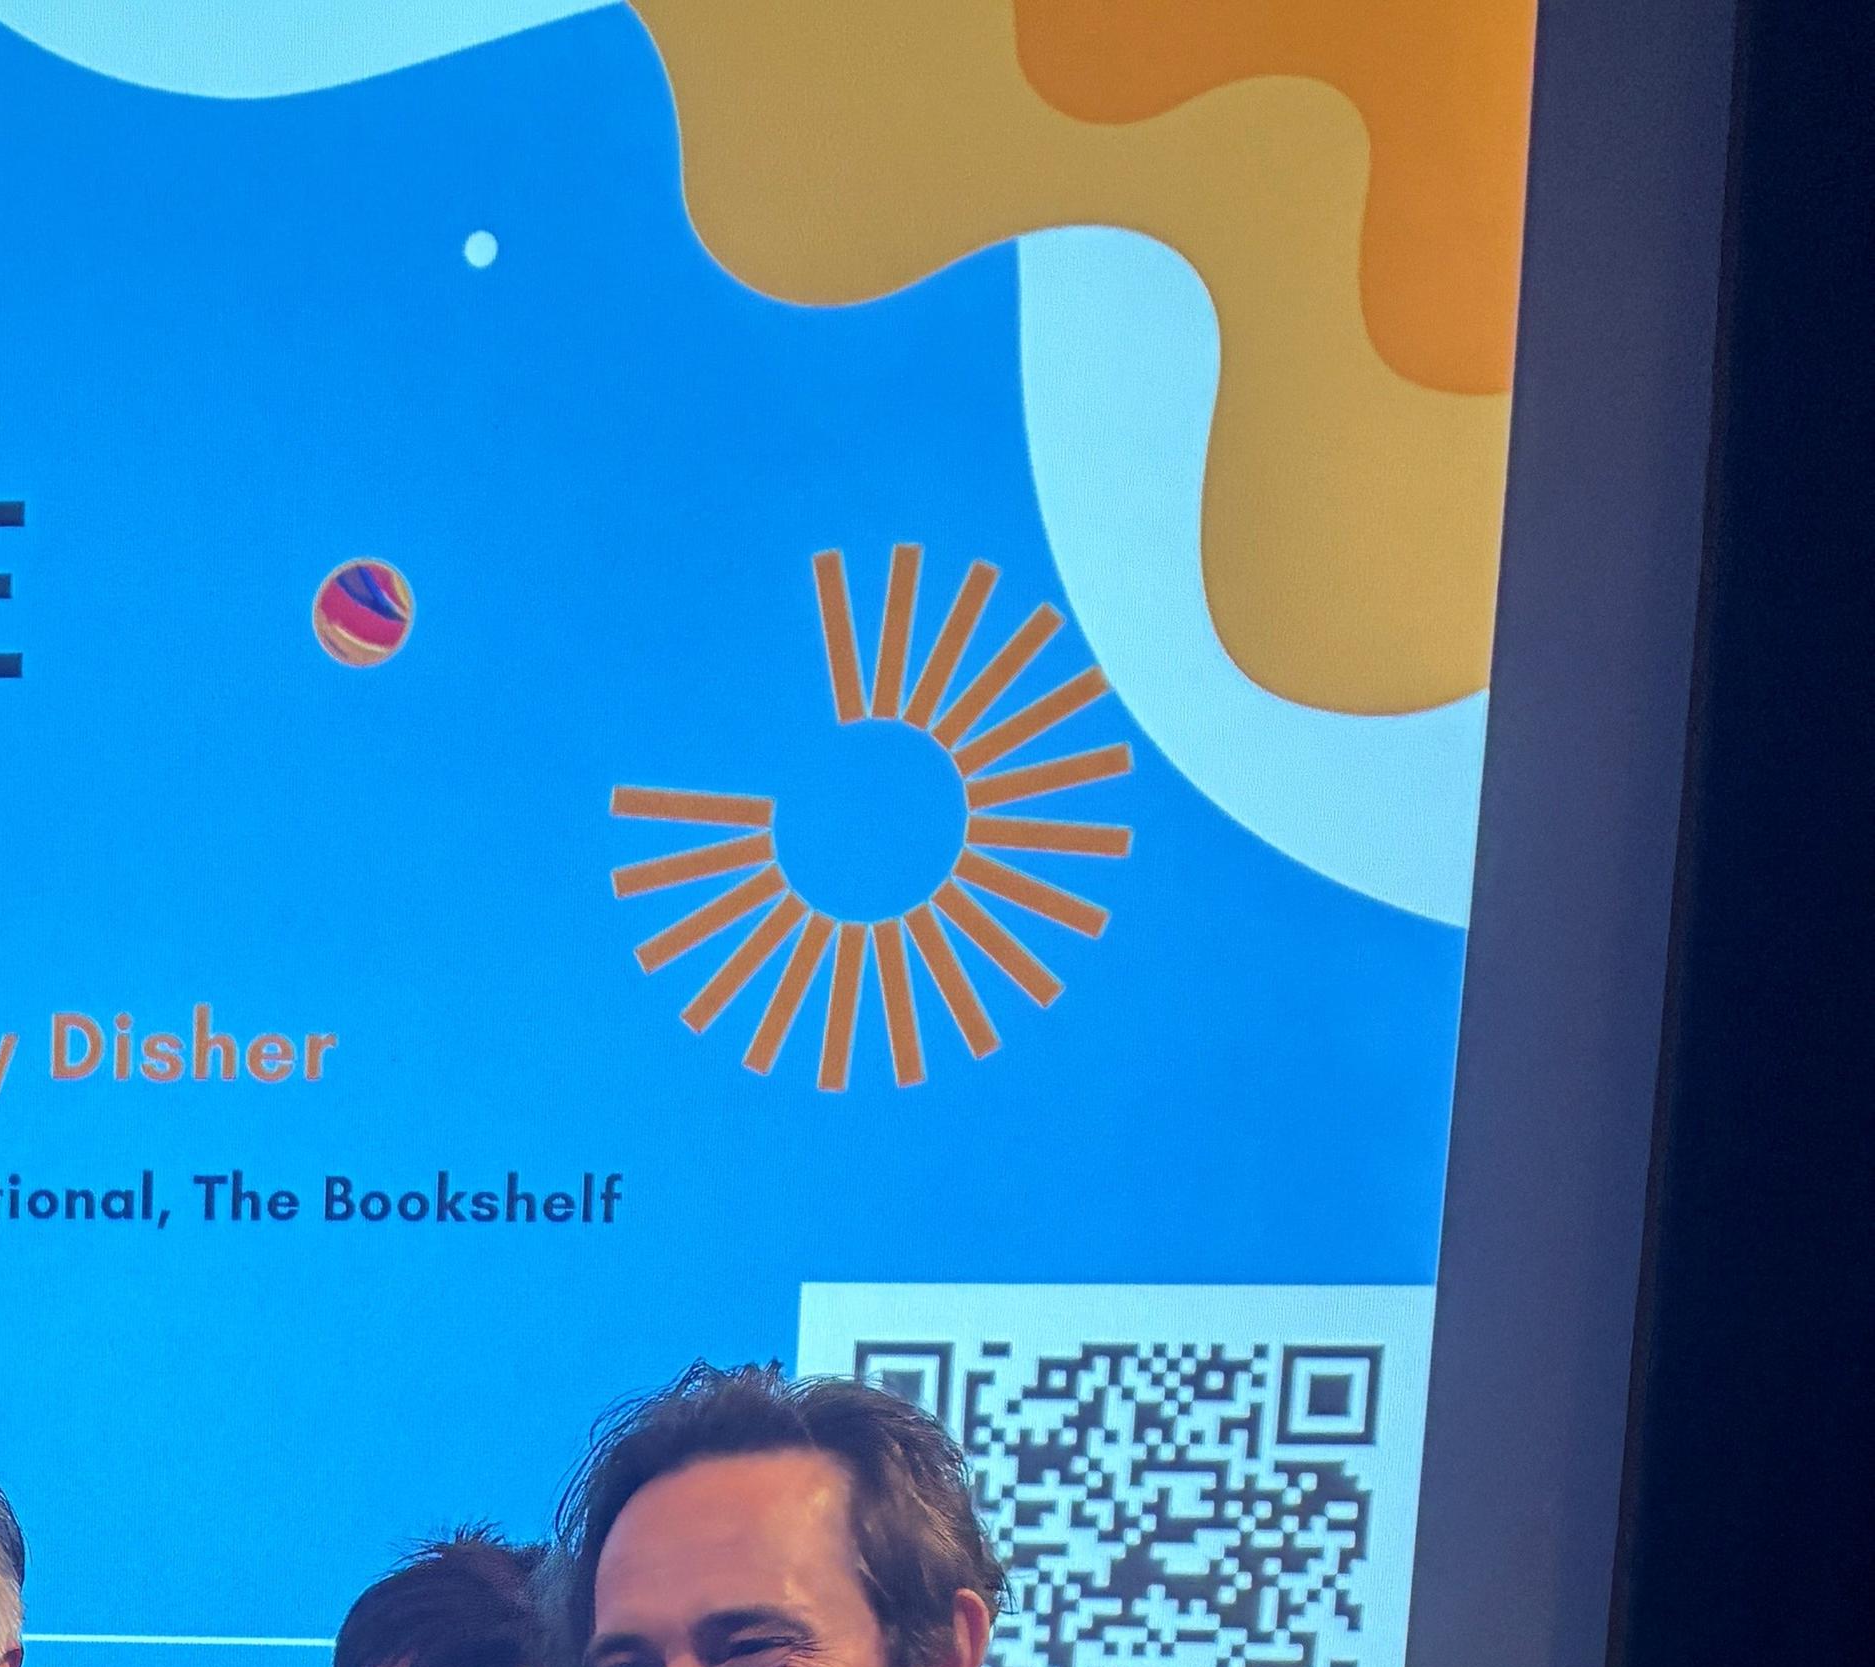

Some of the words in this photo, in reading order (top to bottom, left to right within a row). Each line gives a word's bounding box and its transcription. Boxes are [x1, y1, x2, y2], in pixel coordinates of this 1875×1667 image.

[50, 1001, 337, 1083] Disher
[193, 1170, 300, 1221] The
[324, 1170, 624, 1224] Bookshelf
